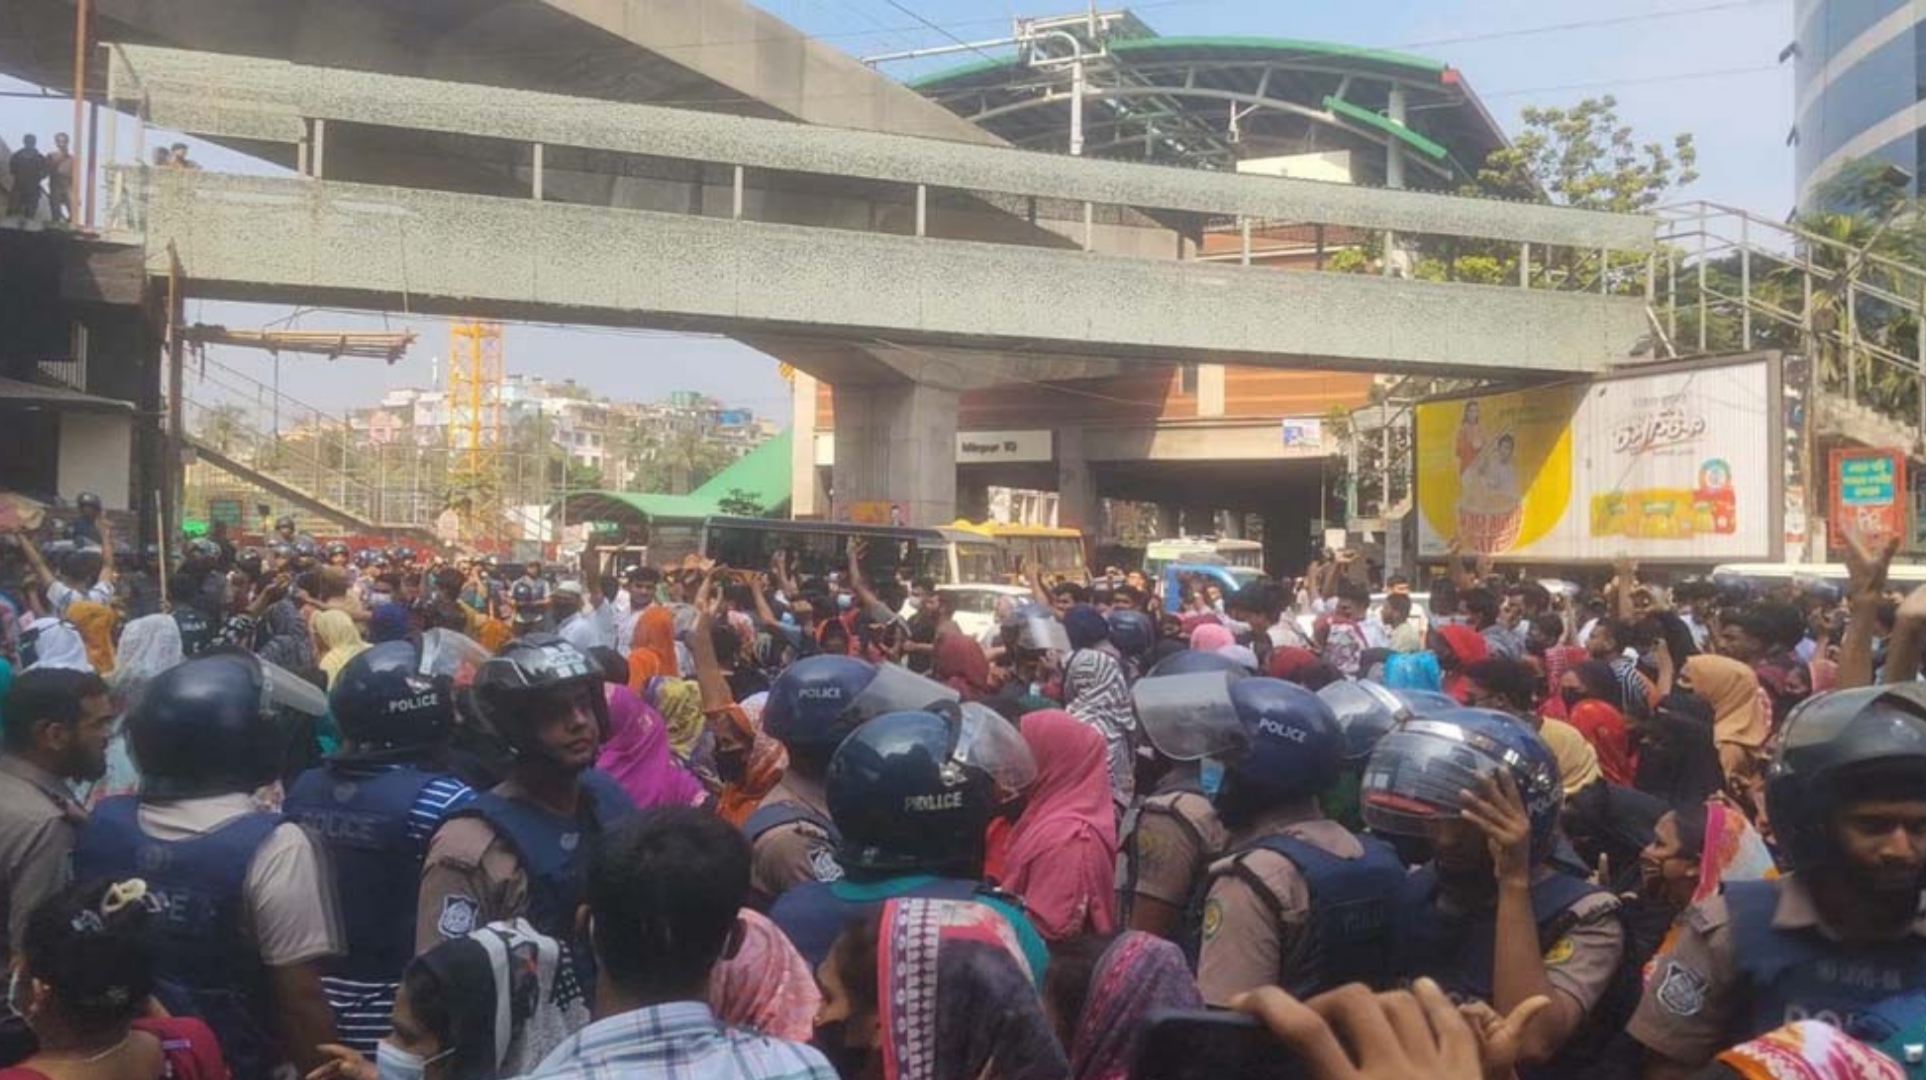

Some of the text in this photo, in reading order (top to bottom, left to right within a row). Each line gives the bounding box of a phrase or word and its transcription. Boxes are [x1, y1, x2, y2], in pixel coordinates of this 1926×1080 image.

[388, 692, 439, 714] POLICE
[798, 687, 842, 699] POLICE
[1259, 717, 1307, 743] POLICE
[904, 791, 963, 813] POLICE
